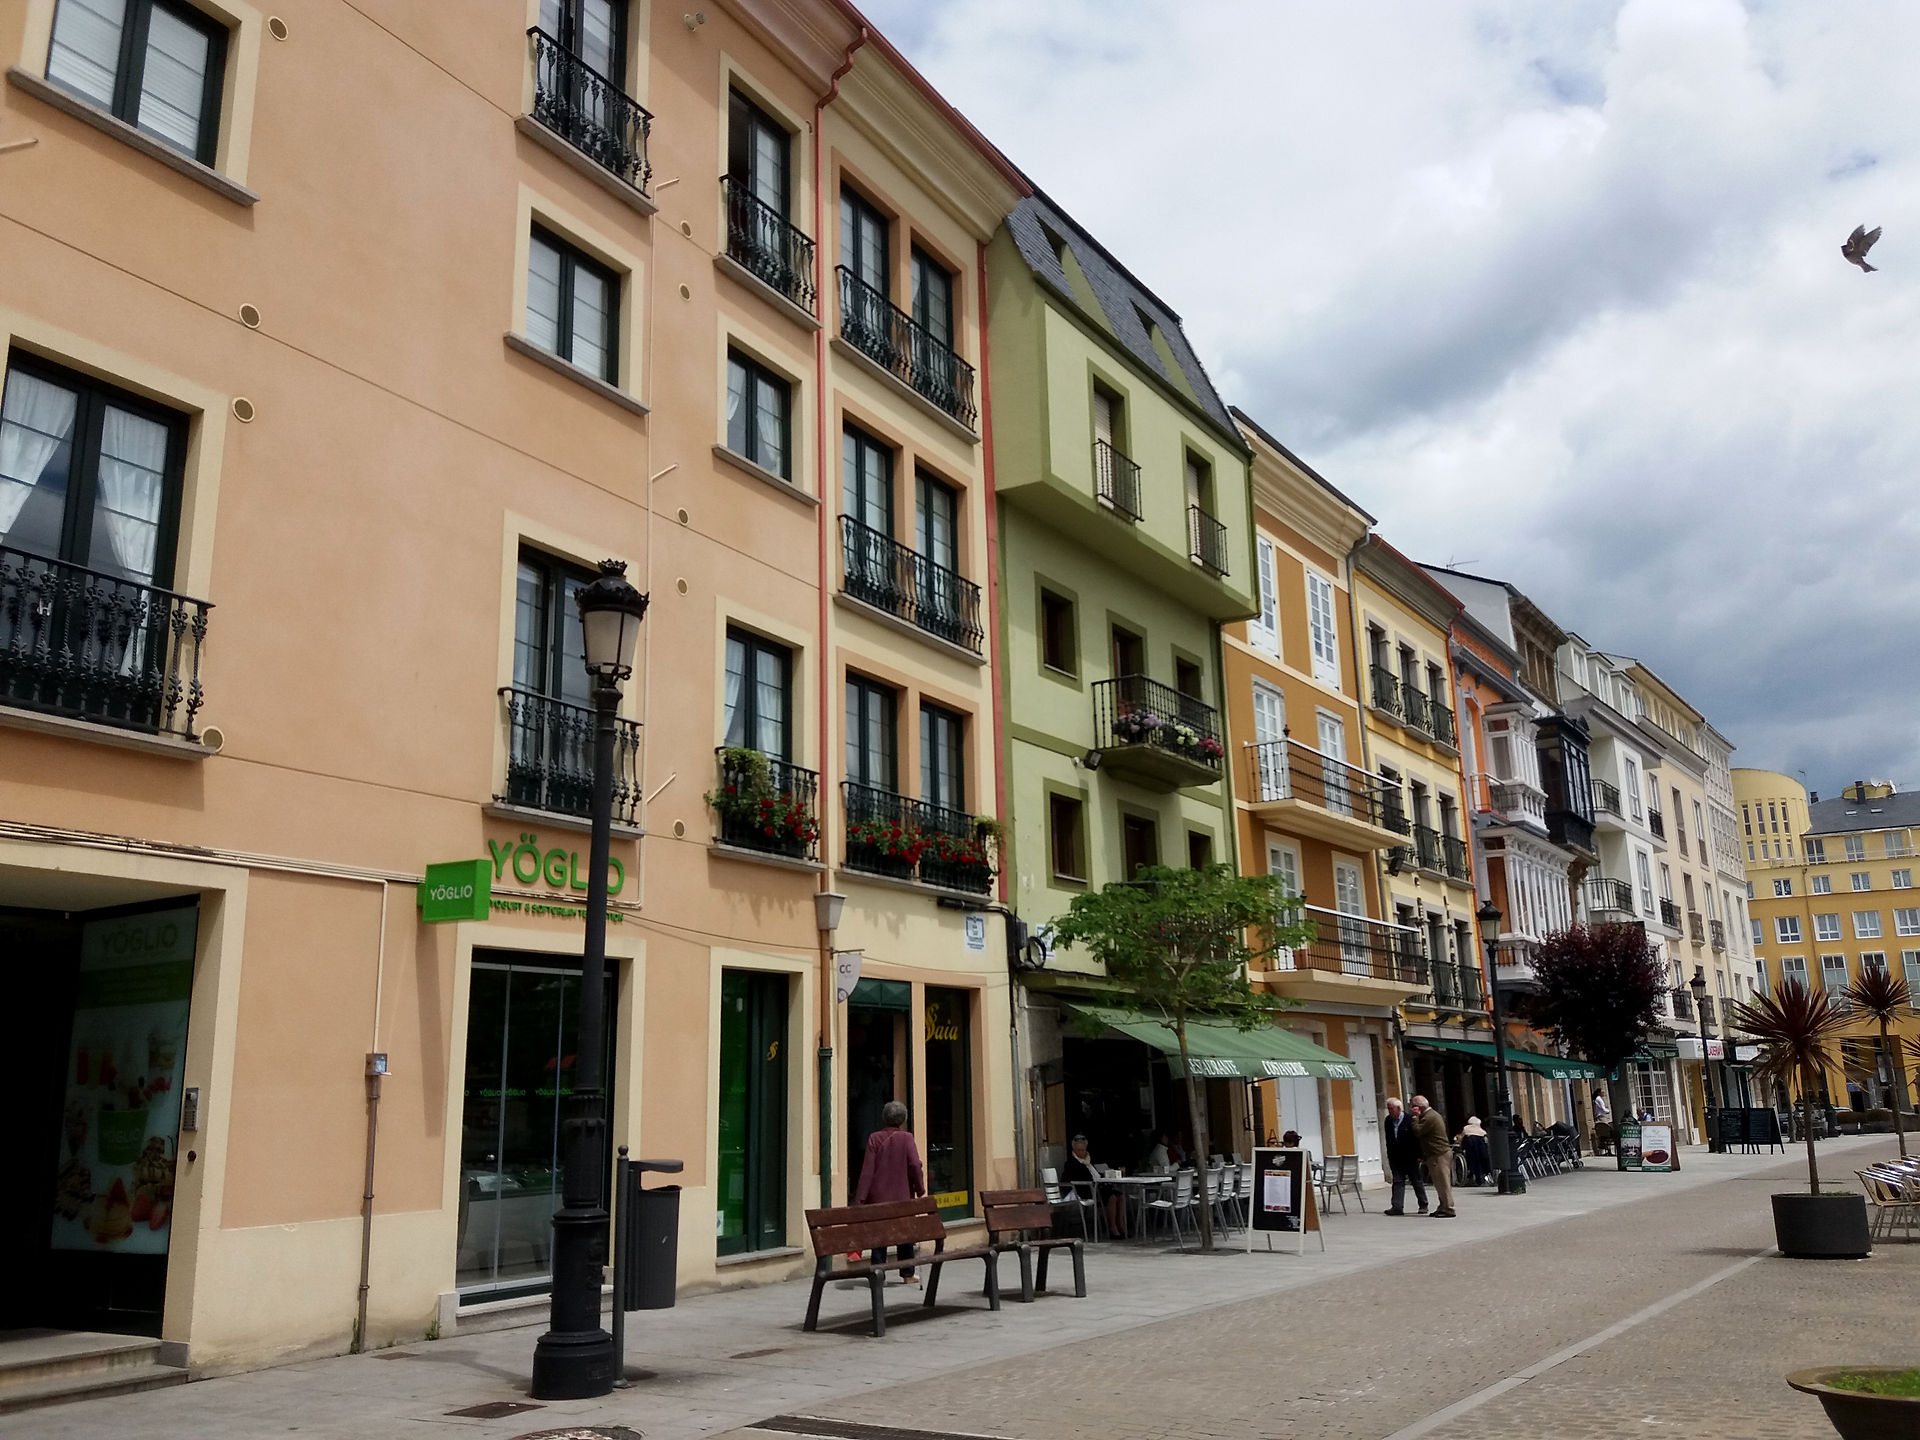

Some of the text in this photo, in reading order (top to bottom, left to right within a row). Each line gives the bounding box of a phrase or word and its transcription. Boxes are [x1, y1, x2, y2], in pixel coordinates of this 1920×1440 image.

[488, 833, 625, 894] YÖGLO
[430, 885, 473, 901] YÖGLIO
[1188, 1058, 1240, 1075] ESTAURANTE
